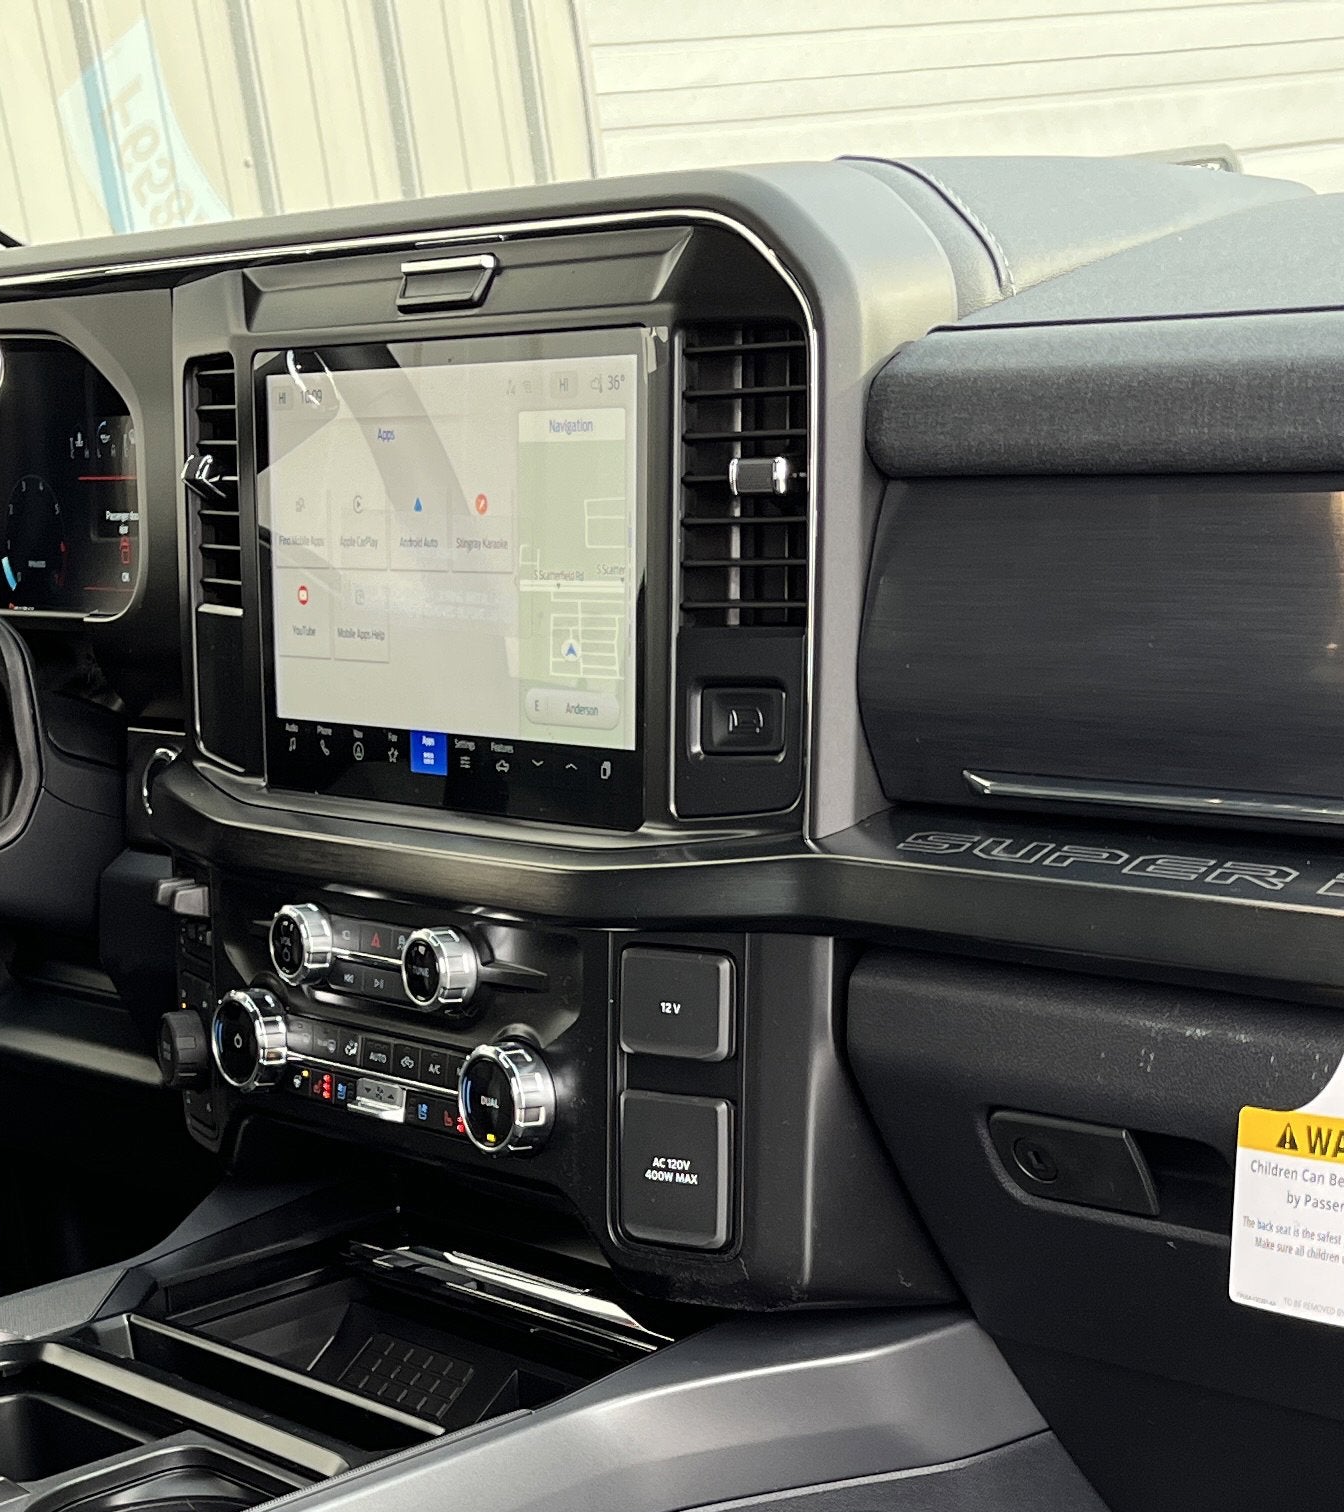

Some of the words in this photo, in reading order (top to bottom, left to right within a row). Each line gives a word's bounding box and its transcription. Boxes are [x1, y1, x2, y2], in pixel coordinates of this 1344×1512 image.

[549, 418, 593, 434] Navigation
[377, 428, 395, 442] Apps
[400, 537, 422, 547] Android
[423, 539, 438, 548] Auto
[293, 625, 316, 636] YouTube
[565, 702, 598, 717] Anderson
[896, 830, 1299, 891] SUPER
[661, 1002, 671, 1014] 12
[673, 1003, 681, 1014] V
[369, 1052, 387, 1064] AUTO
[480, 1096, 499, 1108] DUAL
[653, 1157, 666, 1168] AC
[667, 1159, 690, 1170] 120V
[645, 1170, 673, 1182] 400W
[675, 1173, 698, 1185] MAX
[1250, 1159, 1298, 1181] Children
[1302, 1168, 1325, 1185] Can
[1329, 1173, 1344, 1188] Be
[1287, 1192, 1302, 1208] by
[1243, 1216, 1255, 1228] The
[1257, 1220, 1273, 1231] back
[1276, 1225, 1291, 1235] seat
[1293, 1227, 1299, 1237] is
[1302, 1228, 1315, 1240] the
[1317, 1231, 1341, 1245] safest
[1255, 1236, 1275, 1250] Make
[1277, 1243, 1293, 1254] sure
[1295, 1245, 1304, 1256] all
[1307, 1247, 1339, 1263] children
